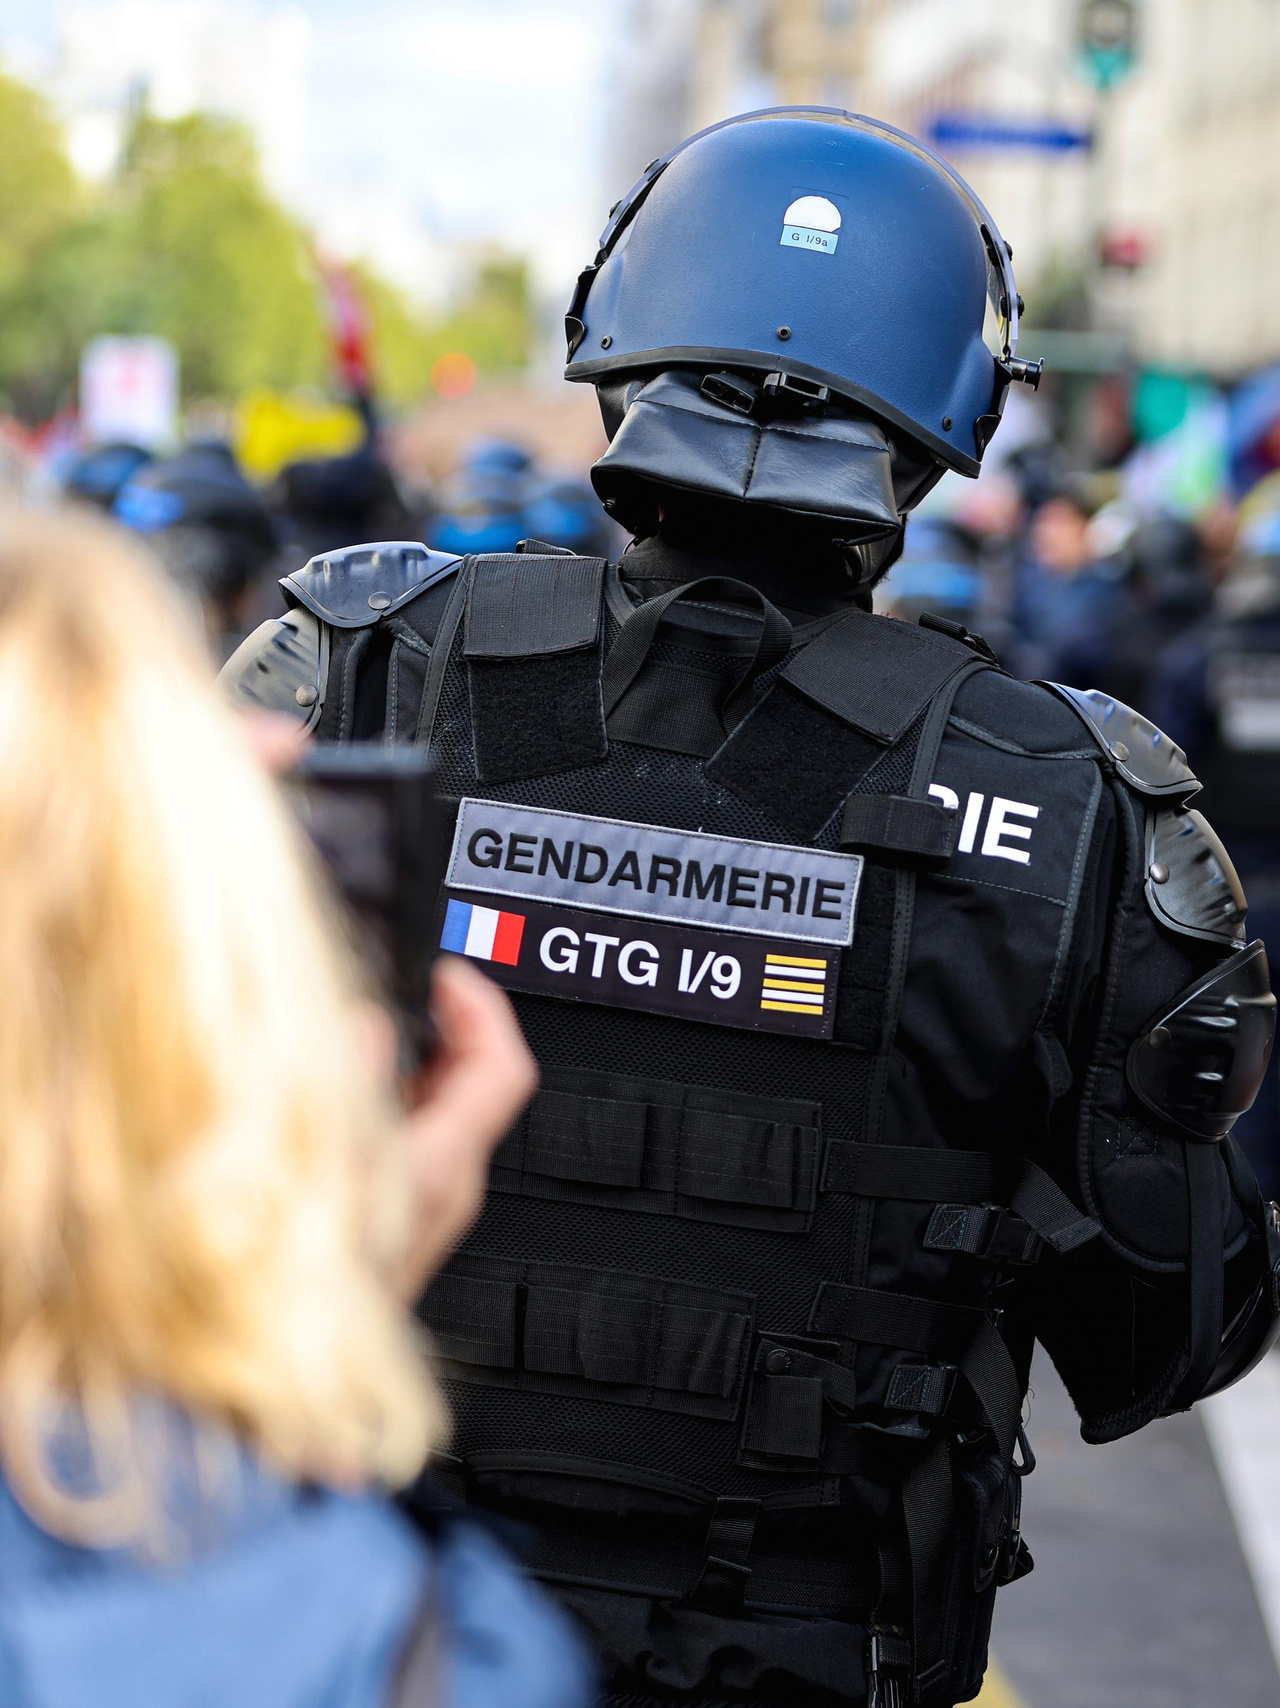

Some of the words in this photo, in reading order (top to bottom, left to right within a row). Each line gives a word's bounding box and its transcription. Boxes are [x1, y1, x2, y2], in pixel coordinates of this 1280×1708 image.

[791, 232, 800, 241] G
[928, 783, 1040, 865] IE
[467, 828, 846, 920] GENDARMERIE
[539, 926, 660, 987] GTG
[678, 948, 742, 999] I/9
